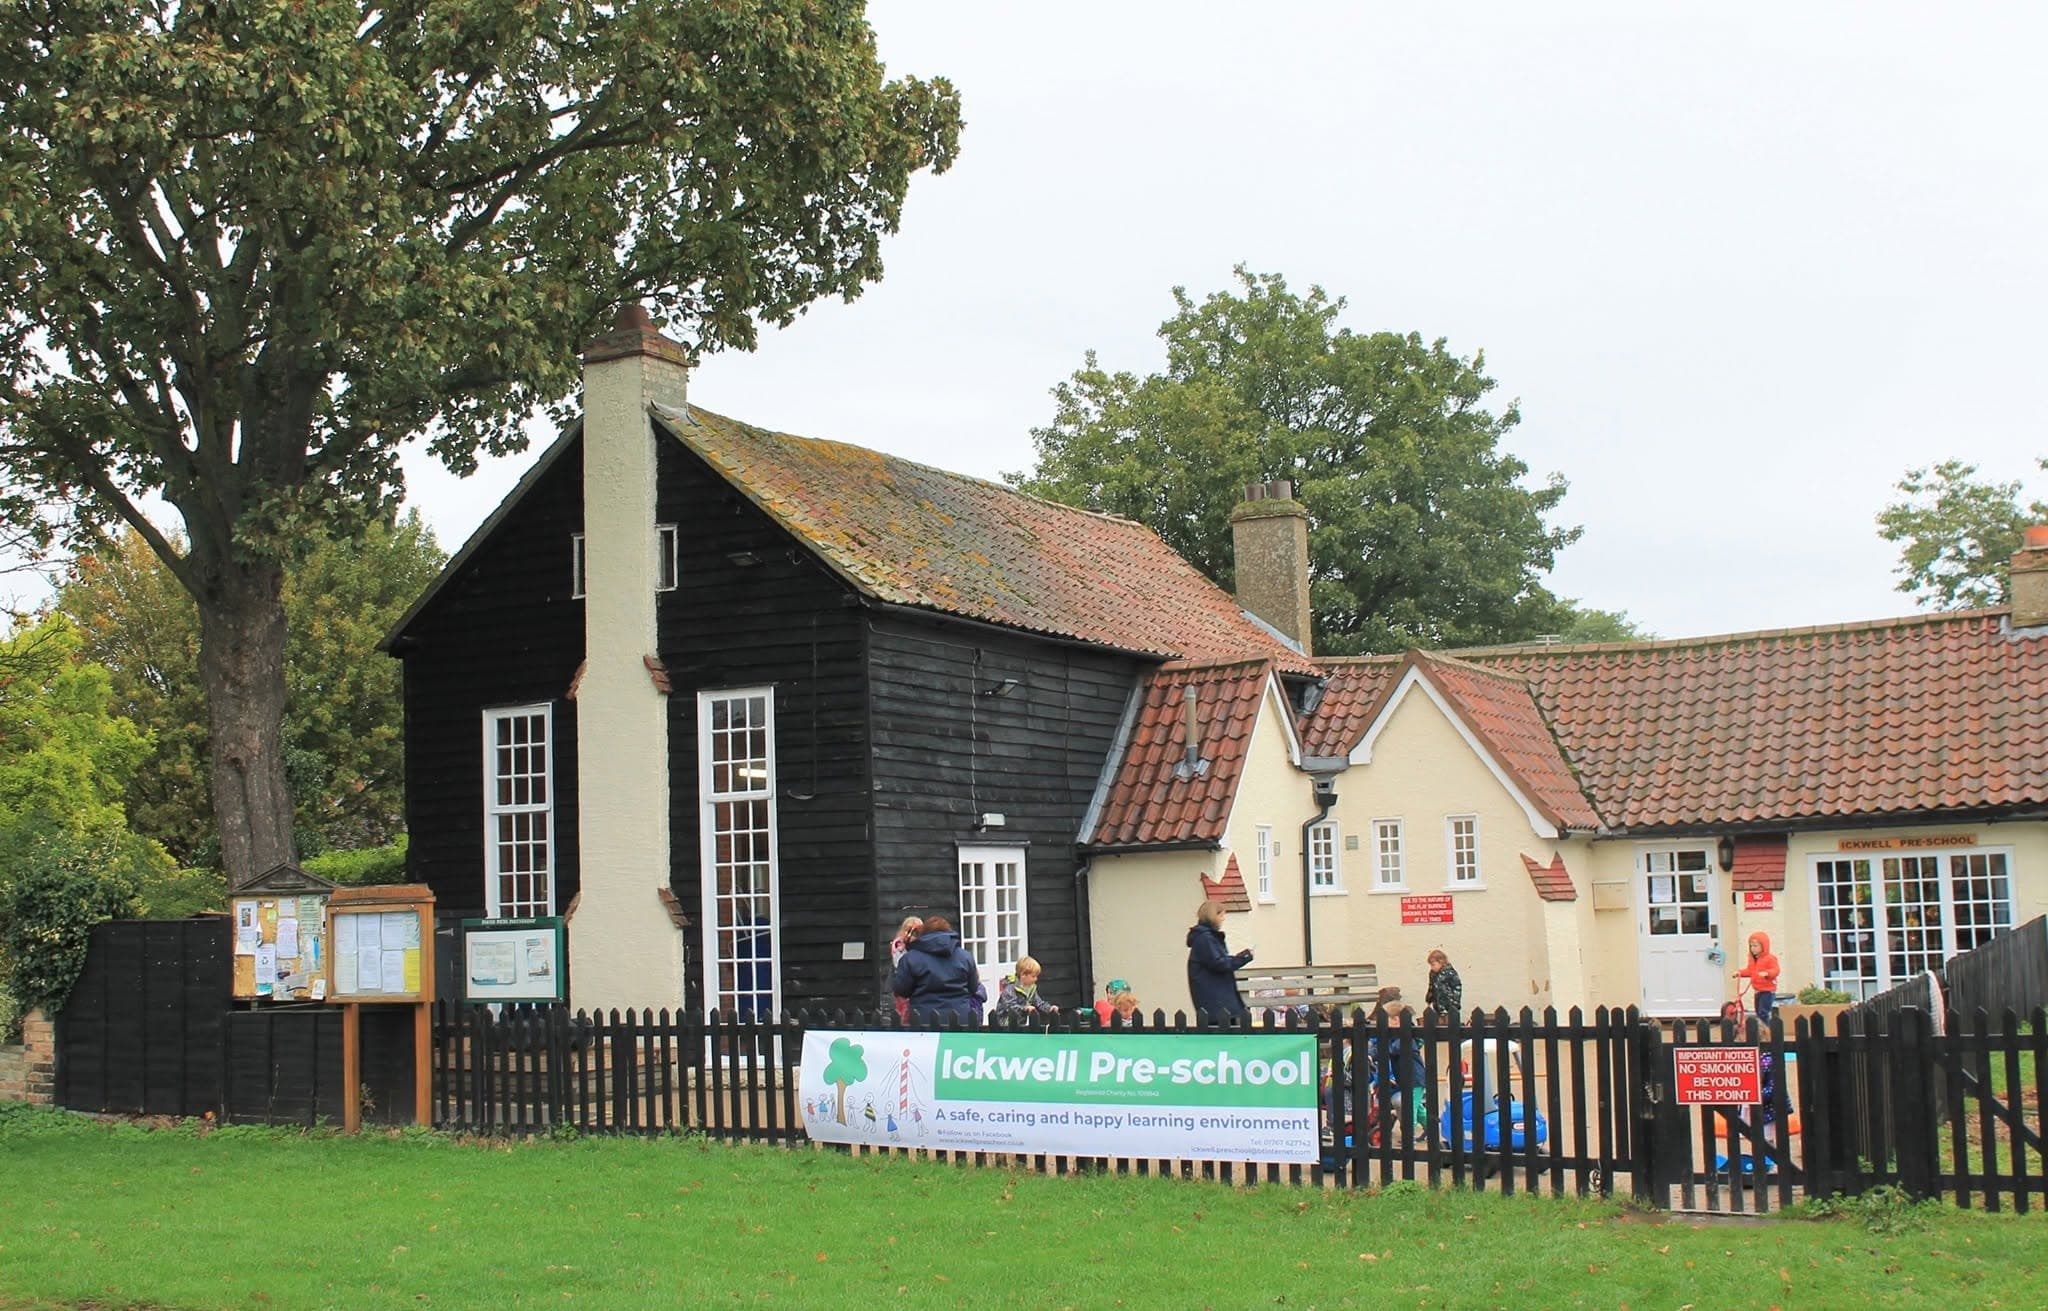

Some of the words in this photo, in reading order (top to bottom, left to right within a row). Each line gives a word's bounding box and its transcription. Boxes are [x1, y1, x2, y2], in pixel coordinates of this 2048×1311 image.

[1841, 840, 1892, 849] ICKWELL
[1900, 836, 1974, 847] PRE-SCHOOL
[1753, 892, 1764, 900] NO
[1678, 1051, 1722, 1060] IMPORTANT
[1725, 1051, 1754, 1059] NOTICE
[942, 1049, 1078, 1083] Ickwell
[1089, 1050, 1310, 1086] Pre-school
[1679, 1064, 1697, 1073] NO
[1700, 1063, 1755, 1073] SMOKING
[1693, 1077, 1741, 1087] BEYOND
[1686, 1090, 1712, 1100] THIS
[1716, 1090, 1751, 1100] POINT
[936, 1108, 946, 1121] A
[950, 1108, 984, 1123] safe,
[988, 1109, 1036, 1126] caring
[1040, 1111, 1069, 1124] and
[1074, 1112, 1122, 1129] happy
[1128, 1113, 1195, 1130] learning
[1200, 1114, 1310, 1131] environment
